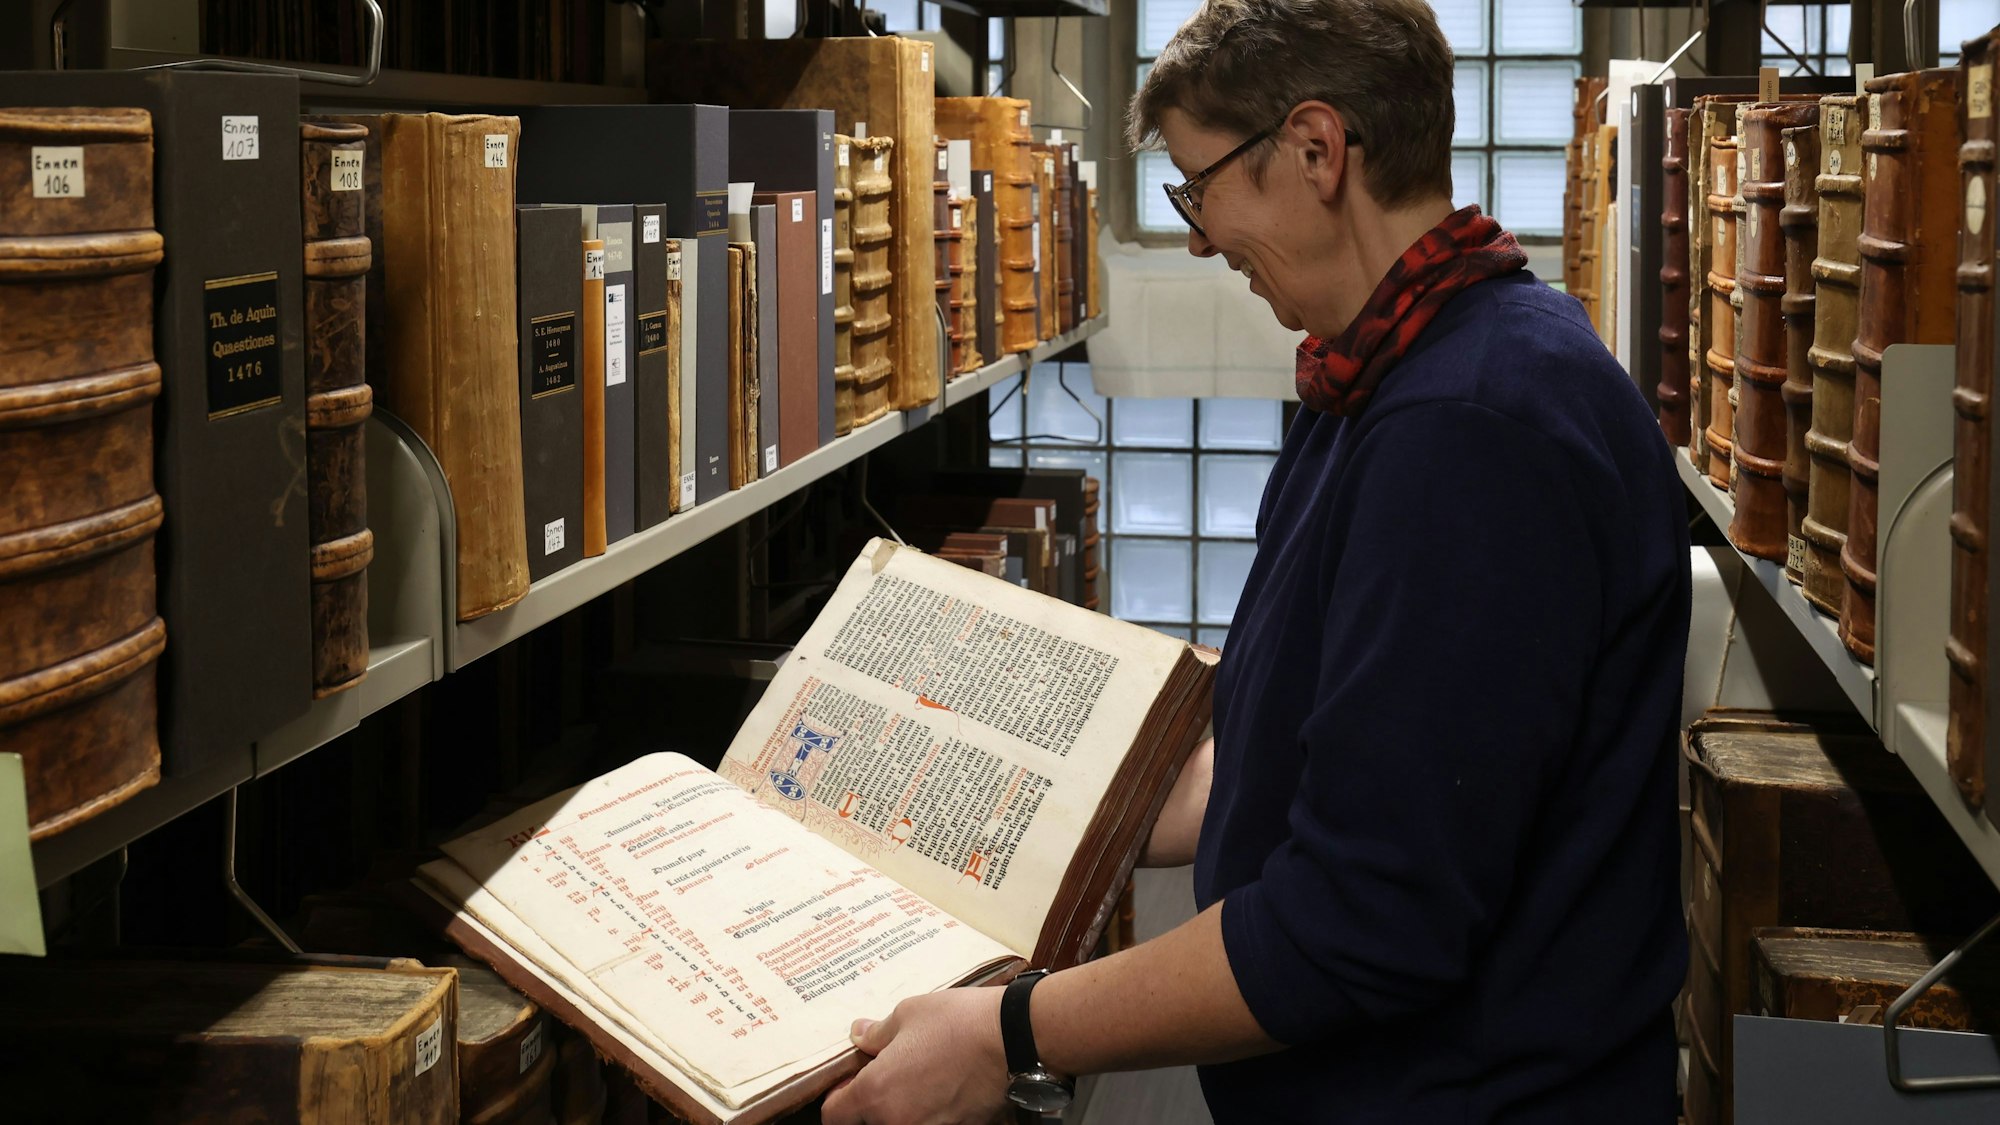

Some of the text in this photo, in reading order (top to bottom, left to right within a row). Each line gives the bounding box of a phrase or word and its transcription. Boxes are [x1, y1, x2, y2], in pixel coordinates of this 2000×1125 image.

[223, 119, 258, 138] Ennen
[226, 138, 255, 158] 107
[486, 139, 504, 149] Ennen
[35, 155, 79, 171] Ennen
[334, 156, 360, 168] Ennen
[44, 175, 71, 194] 106
[340, 171, 359, 188] 108
[210, 304, 276, 328] Th. de Aquin
[212, 332, 276, 358] Quaestiones
[227, 361, 263, 382] 1476
[418, 1028, 440, 1052] Ennen
